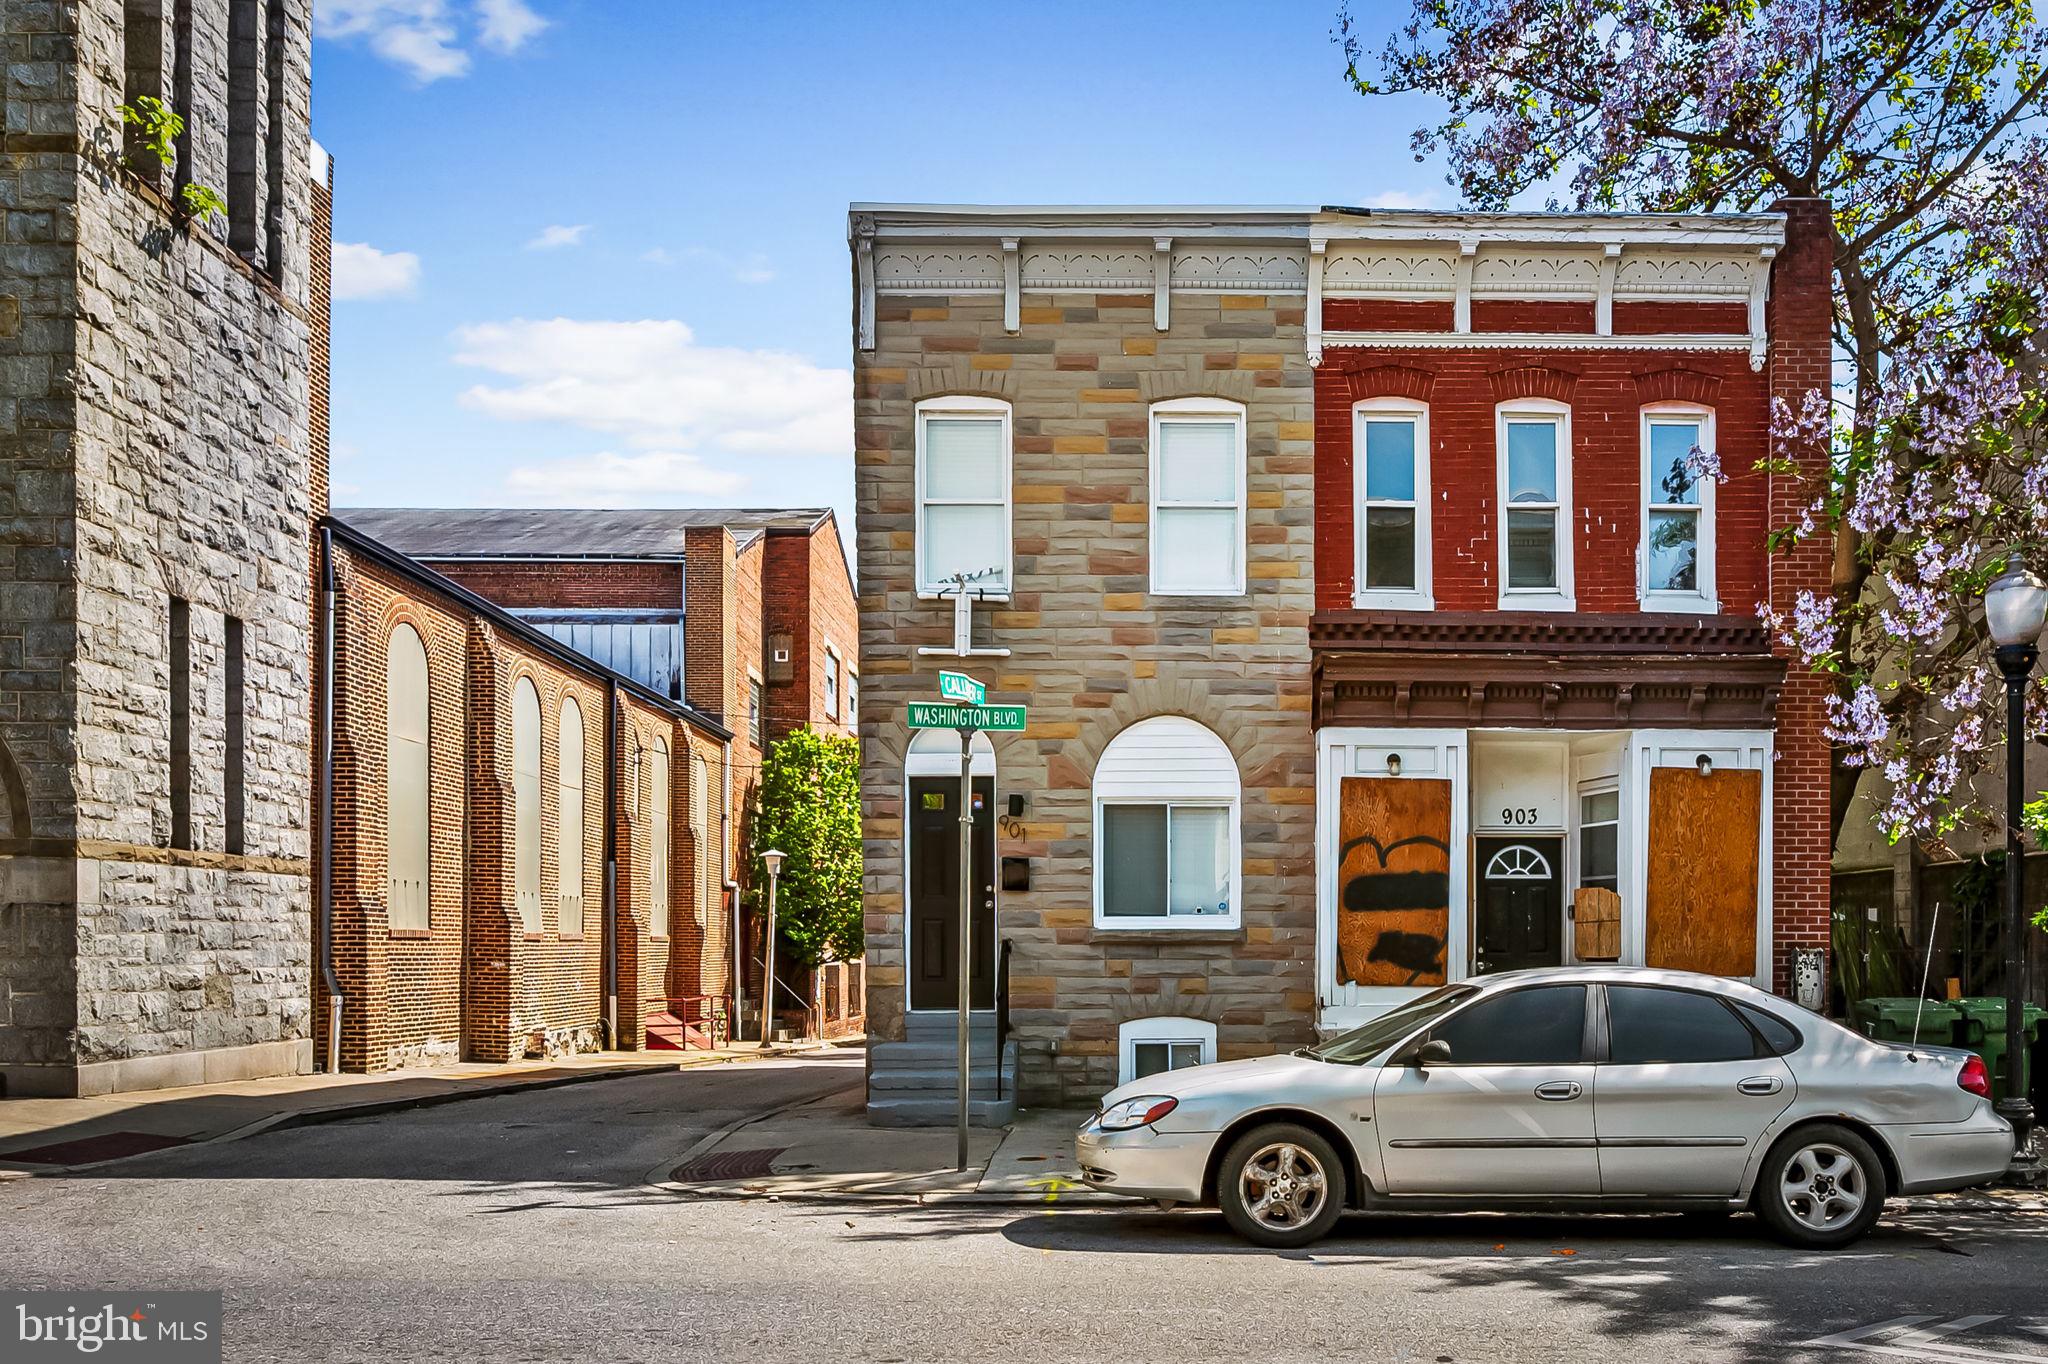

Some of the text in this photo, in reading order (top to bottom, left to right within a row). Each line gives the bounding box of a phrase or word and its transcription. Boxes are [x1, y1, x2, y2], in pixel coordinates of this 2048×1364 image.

[914, 707, 1020, 727] WASHINGTON BLVD.
[1501, 808, 1538, 825] 903
[999, 815, 1026, 845] 901
